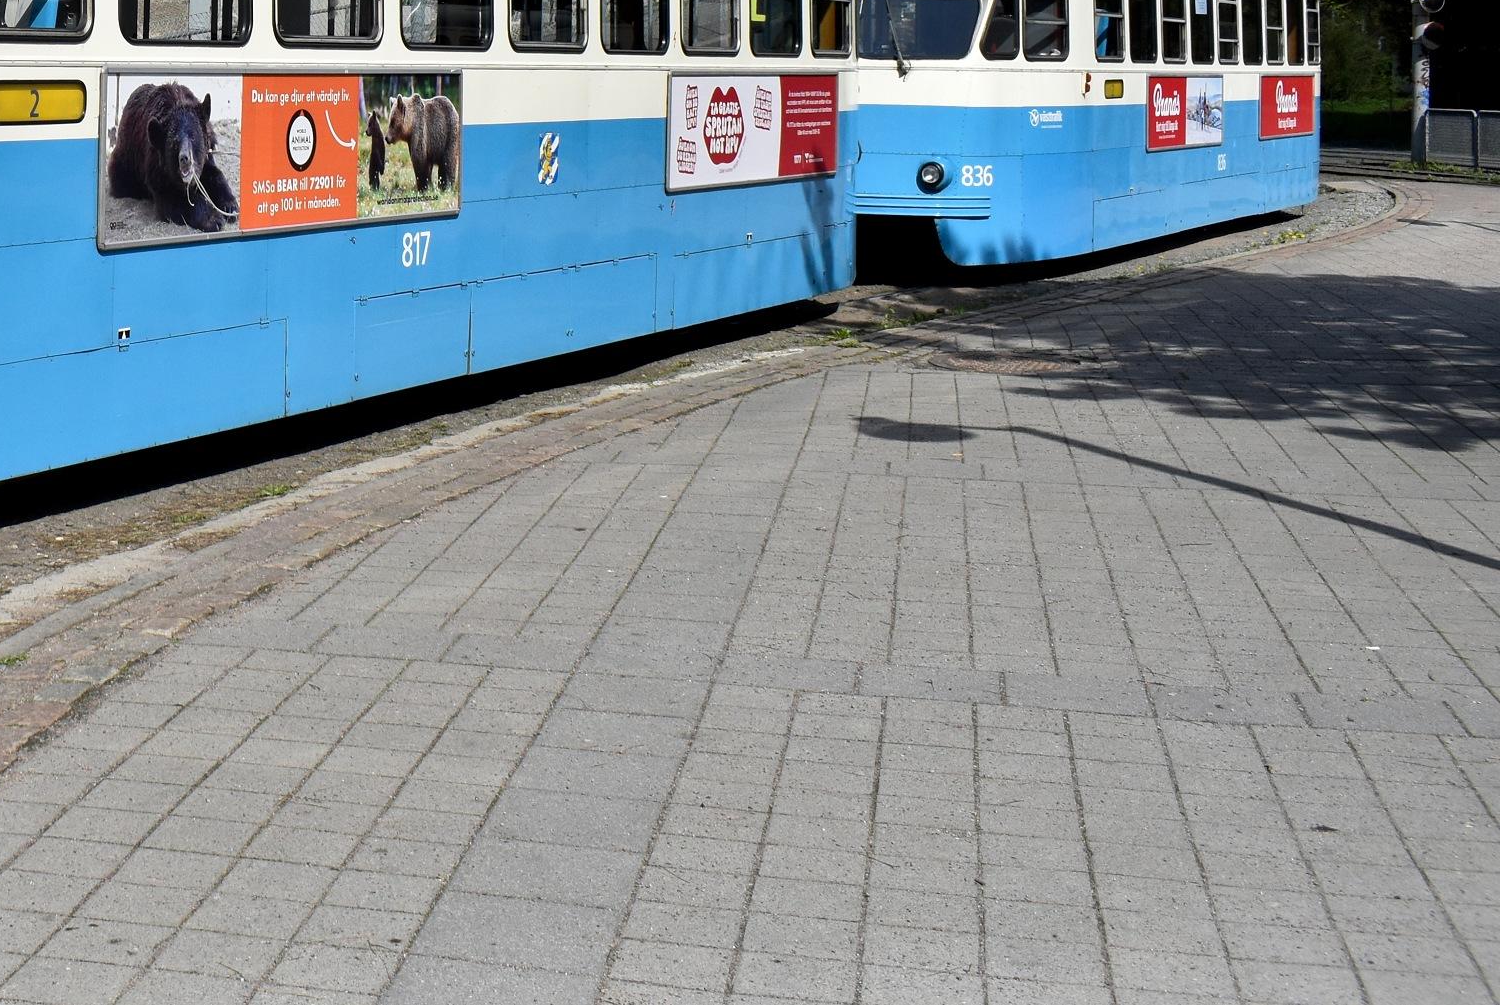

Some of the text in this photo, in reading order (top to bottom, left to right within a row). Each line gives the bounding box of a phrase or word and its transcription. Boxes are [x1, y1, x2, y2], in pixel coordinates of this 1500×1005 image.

[30, 89, 40, 118] 2
[252, 88, 350, 106] Du kan ge djur ett värdigt liv.
[291, 136, 311, 144] ANIMAL
[277, 178, 298, 192] BEAR
[300, 177, 308, 191] till
[310, 175, 334, 190] 72901
[336, 174, 346, 188] för
[961, 165, 993, 186] 836
[257, 201, 268, 213] att
[269, 202, 279, 216] ge
[281, 198, 294, 212] 100
[296, 197, 302, 210] kr
[308, 195, 341, 209] månaden.
[402, 231, 431, 267] 817
